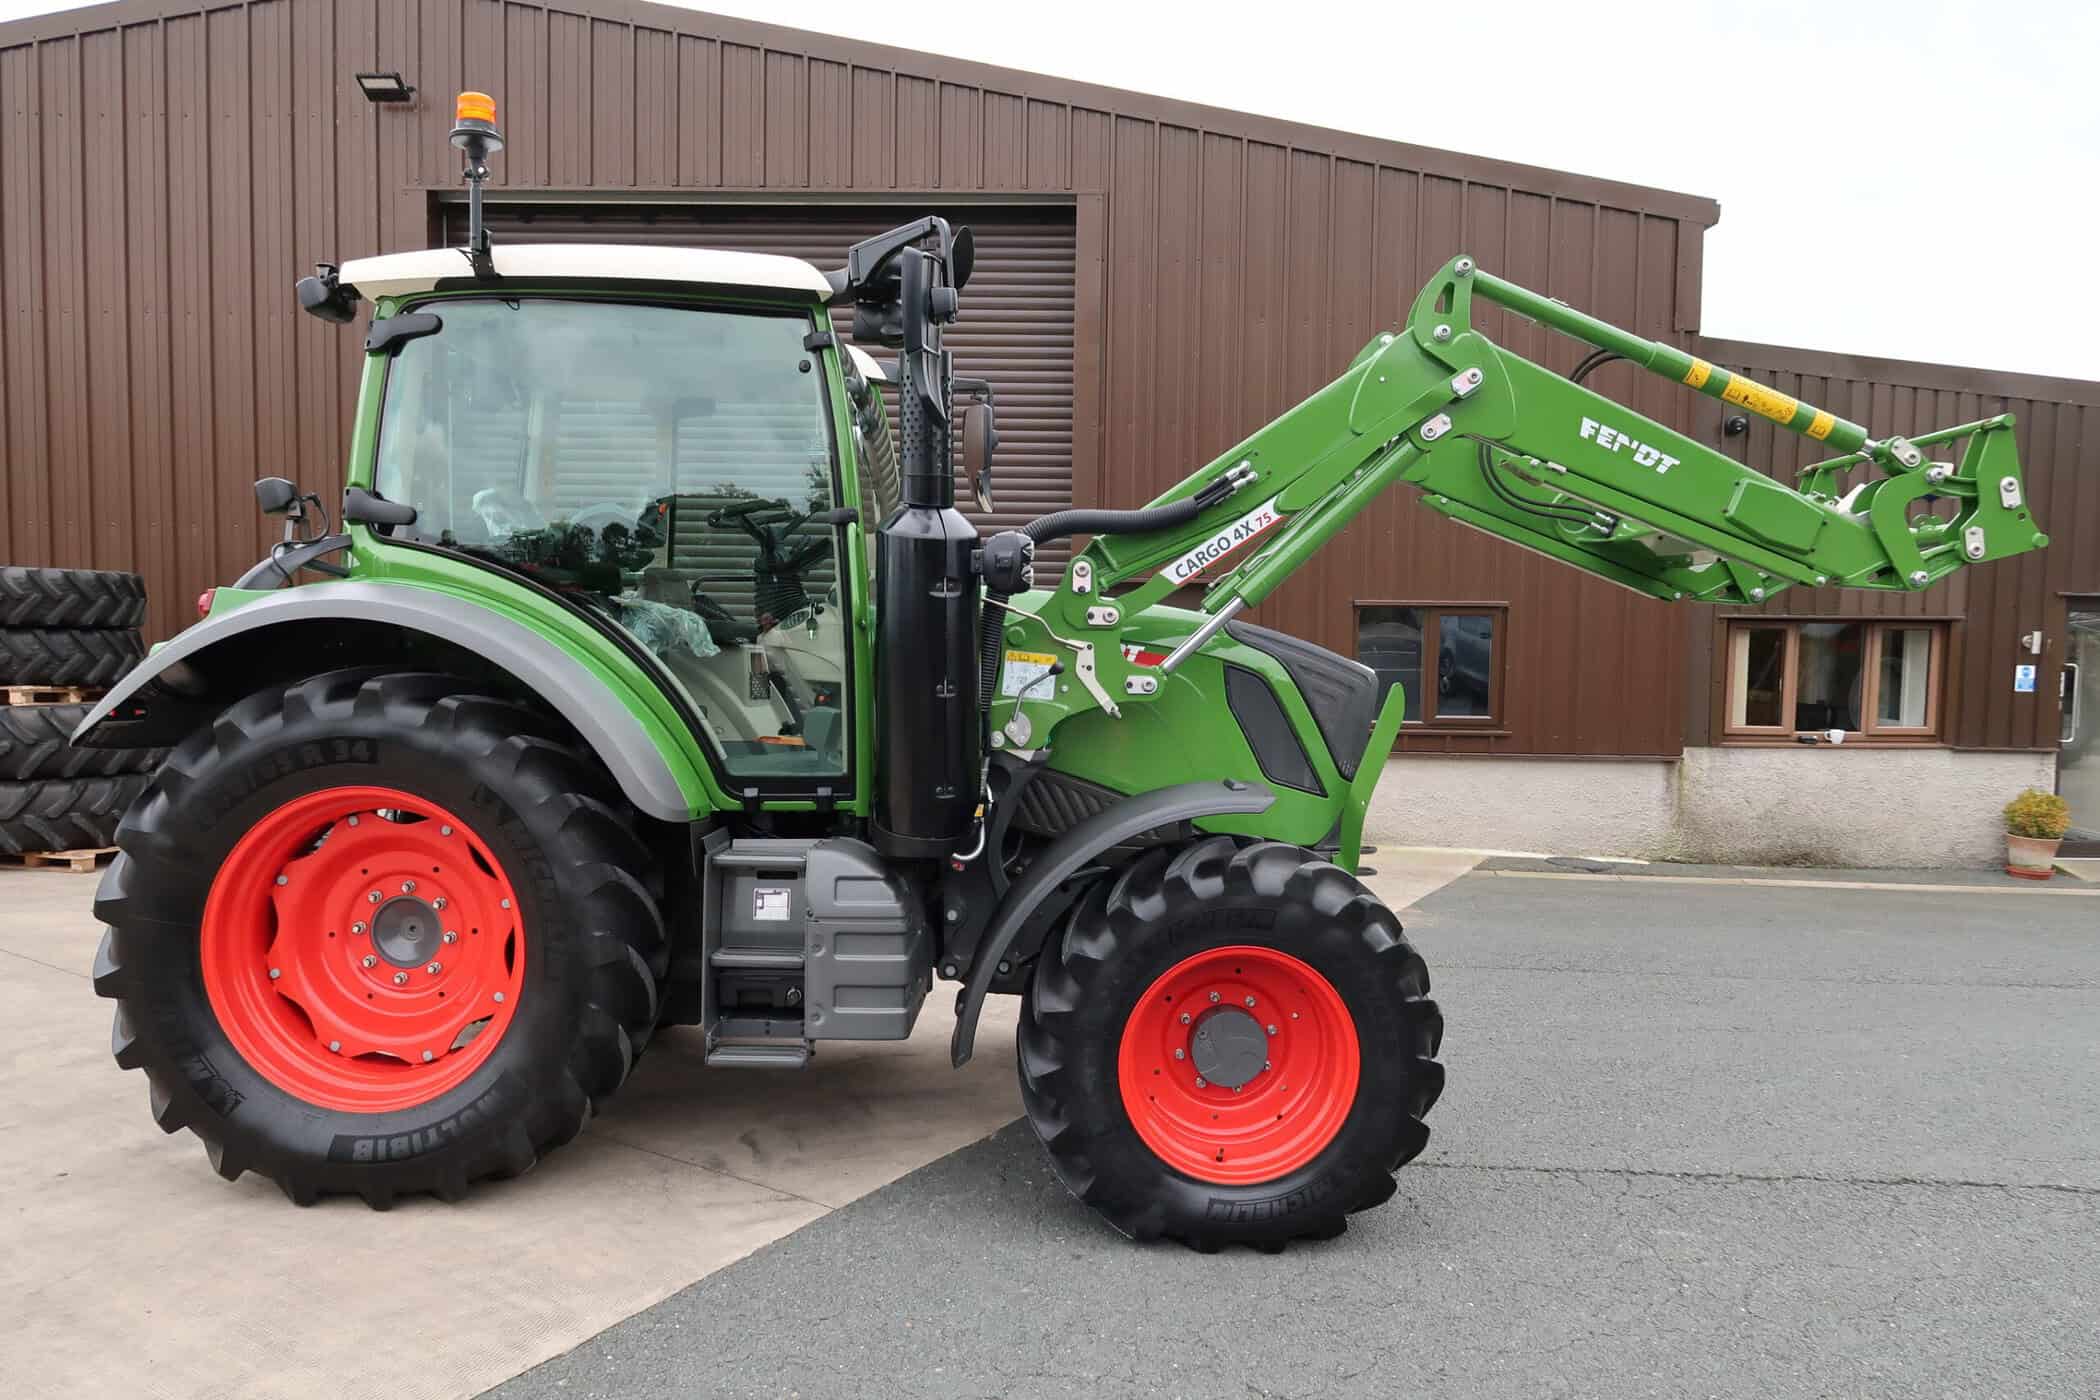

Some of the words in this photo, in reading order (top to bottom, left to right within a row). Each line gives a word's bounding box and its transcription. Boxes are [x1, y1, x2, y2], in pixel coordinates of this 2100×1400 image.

[1580, 417, 1680, 474] FENDT
[1175, 537, 1231, 578] CARGO
[1233, 520, 1255, 540] 4X
[1256, 512, 1272, 528] 75
[353, 1087, 501, 1160] MULTIBIB
[1212, 1178, 1333, 1220] MICHELIN
